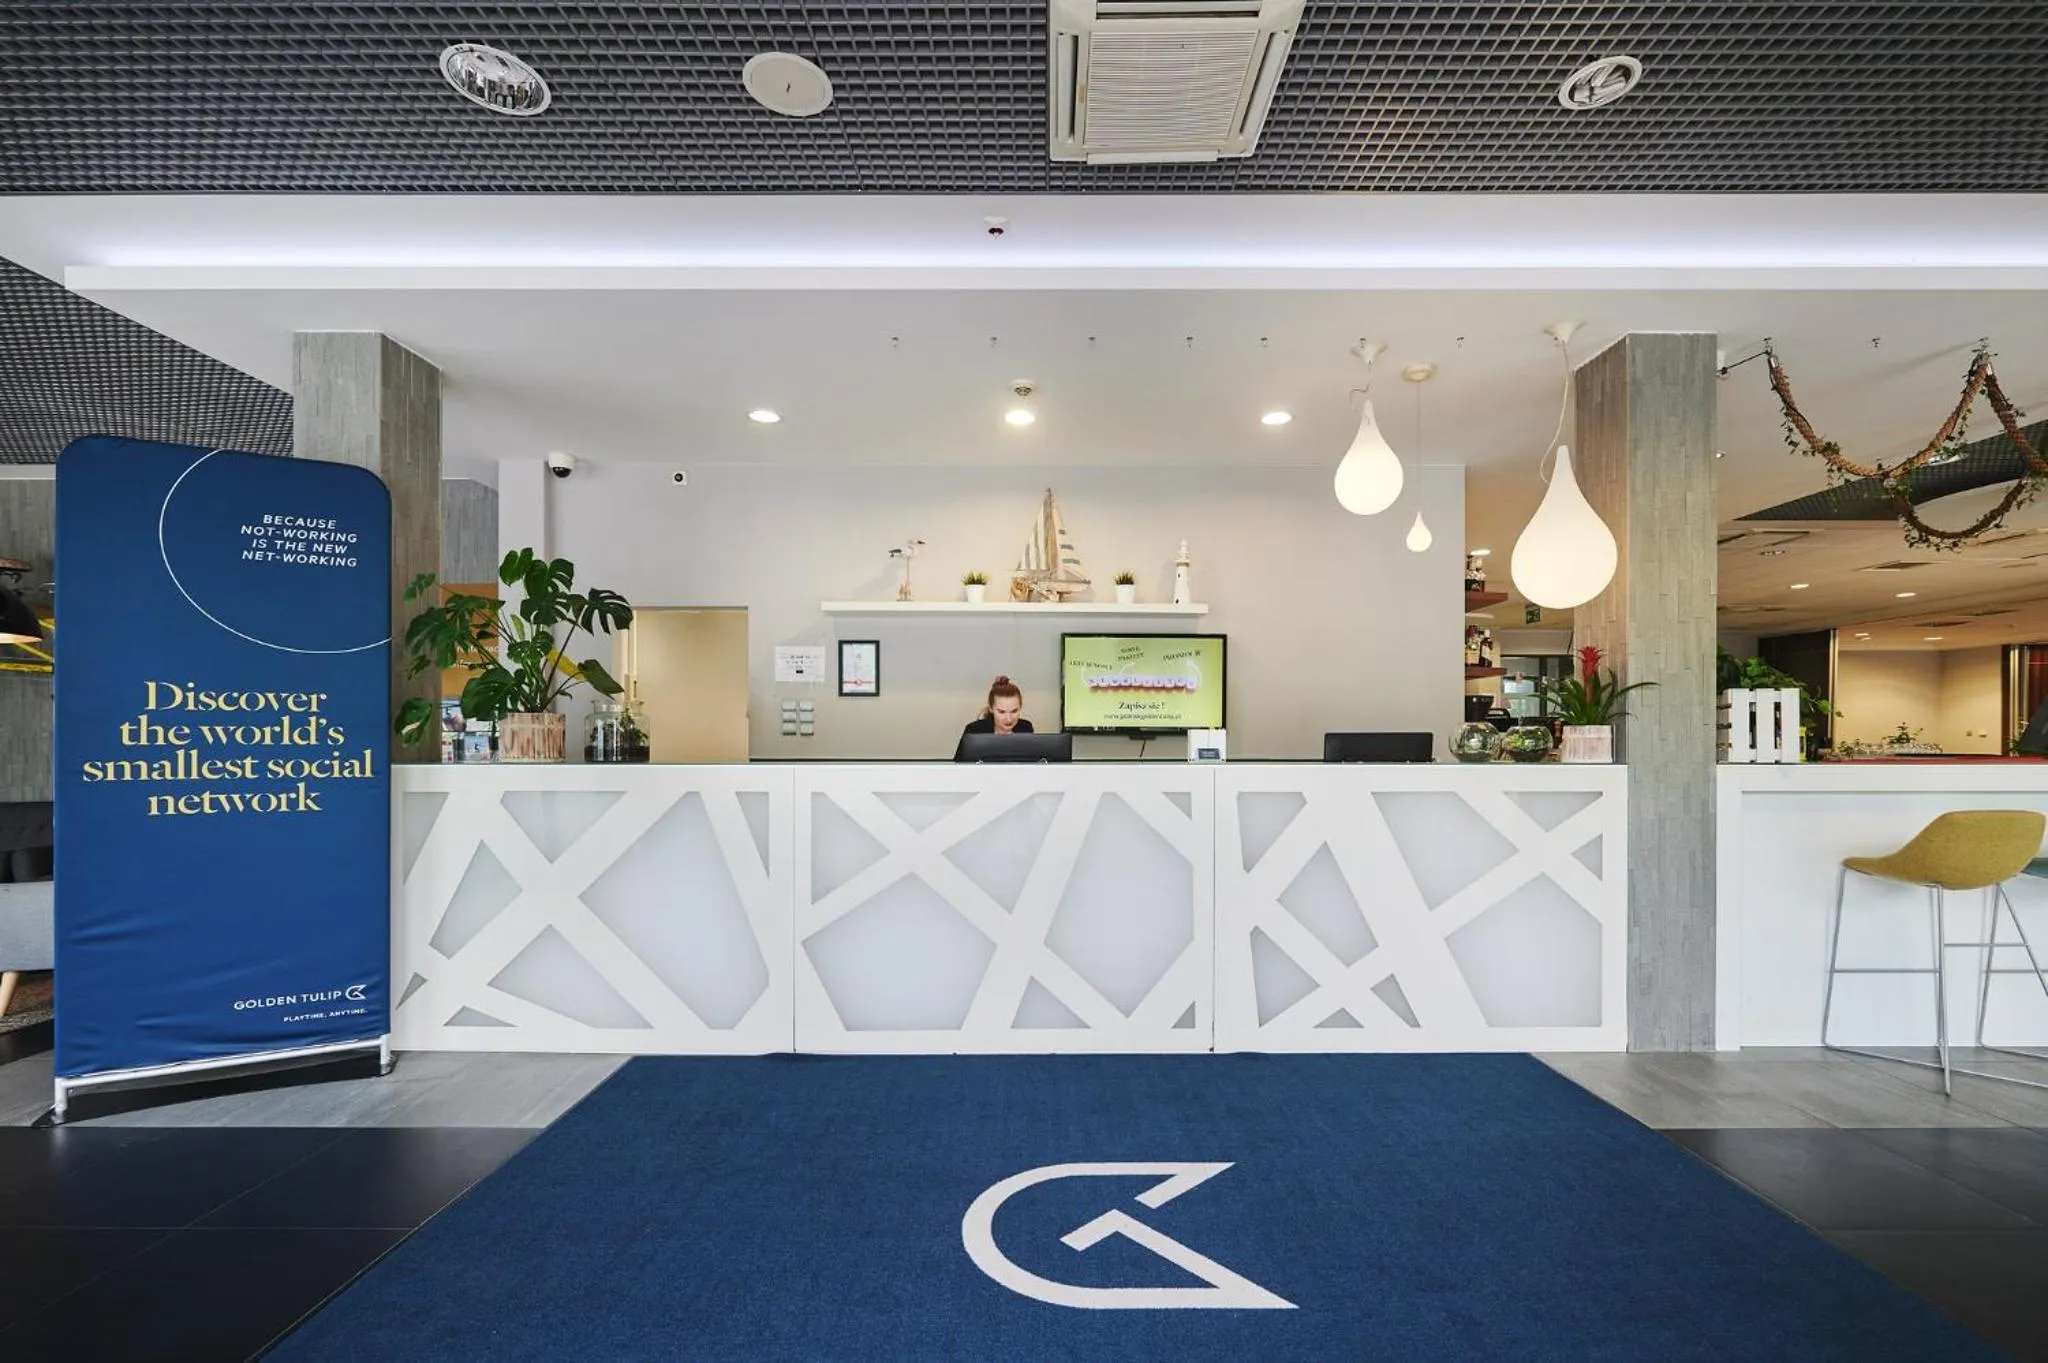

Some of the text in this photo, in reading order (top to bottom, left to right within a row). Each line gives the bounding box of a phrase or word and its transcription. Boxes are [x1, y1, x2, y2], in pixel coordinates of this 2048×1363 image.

[263, 514, 336, 530] BECAUSE
[240, 525, 358, 543] NOT-WORKING
[252, 538, 348, 554] IS THE NEW
[241, 550, 358, 568] NET-WORKING
[143, 681, 327, 712] Discover
[120, 714, 192, 746] the
[82, 749, 375, 782] smallest social
[147, 782, 323, 816] network
[233, 995, 297, 1011] GOLDEN
[301, 990, 342, 1003] TULIP
